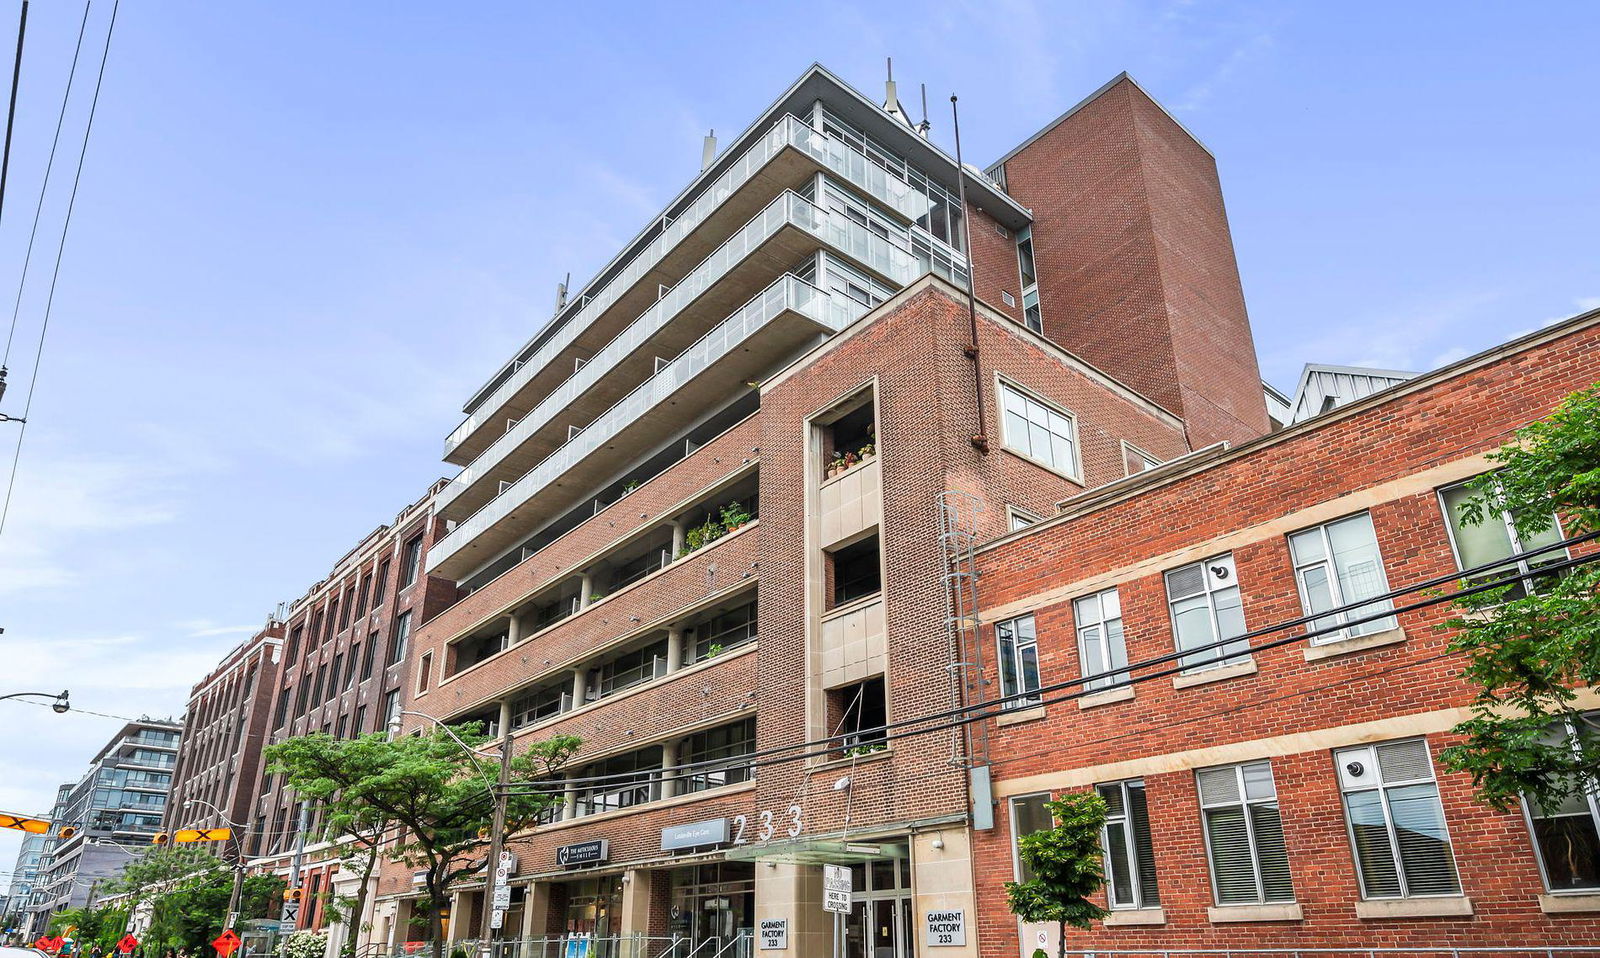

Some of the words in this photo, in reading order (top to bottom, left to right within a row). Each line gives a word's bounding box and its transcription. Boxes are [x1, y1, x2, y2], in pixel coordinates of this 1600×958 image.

[828, 892, 840, 901] HERE
[827, 900, 848, 910] CROSSING
[928, 913, 962, 922] GARMENT
[761, 921, 785, 929] GARMENT
[929, 923, 961, 933] FACTORY
[762, 930, 784, 938] FACTORY
[938, 934, 952, 943] 233
[768, 939, 778, 947] 233
